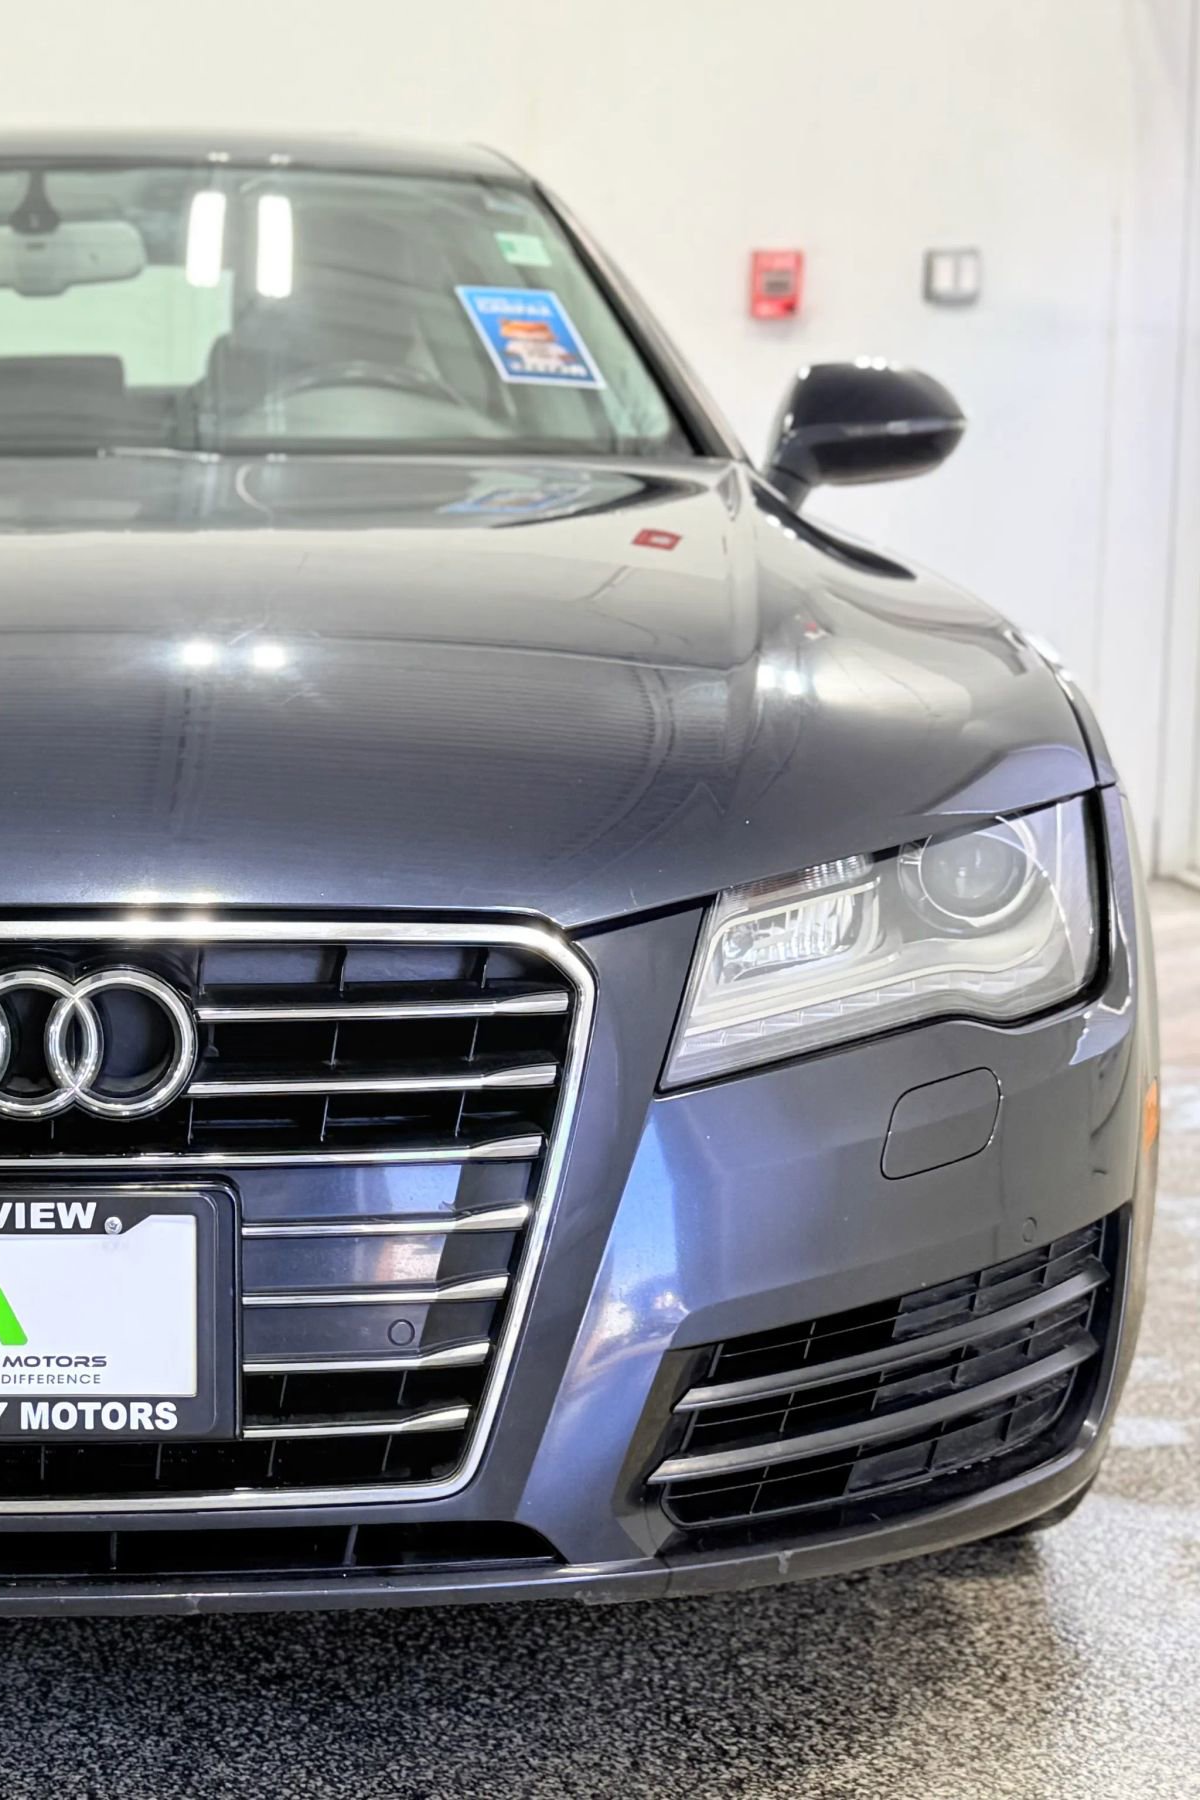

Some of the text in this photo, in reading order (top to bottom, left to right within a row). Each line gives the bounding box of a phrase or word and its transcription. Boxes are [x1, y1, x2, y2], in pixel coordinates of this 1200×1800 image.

[2, 1355, 107, 1368] MOTORS
[1, 1373, 101, 1385] DIFFERENCE
[20, 1401, 178, 1431] MOTORS
